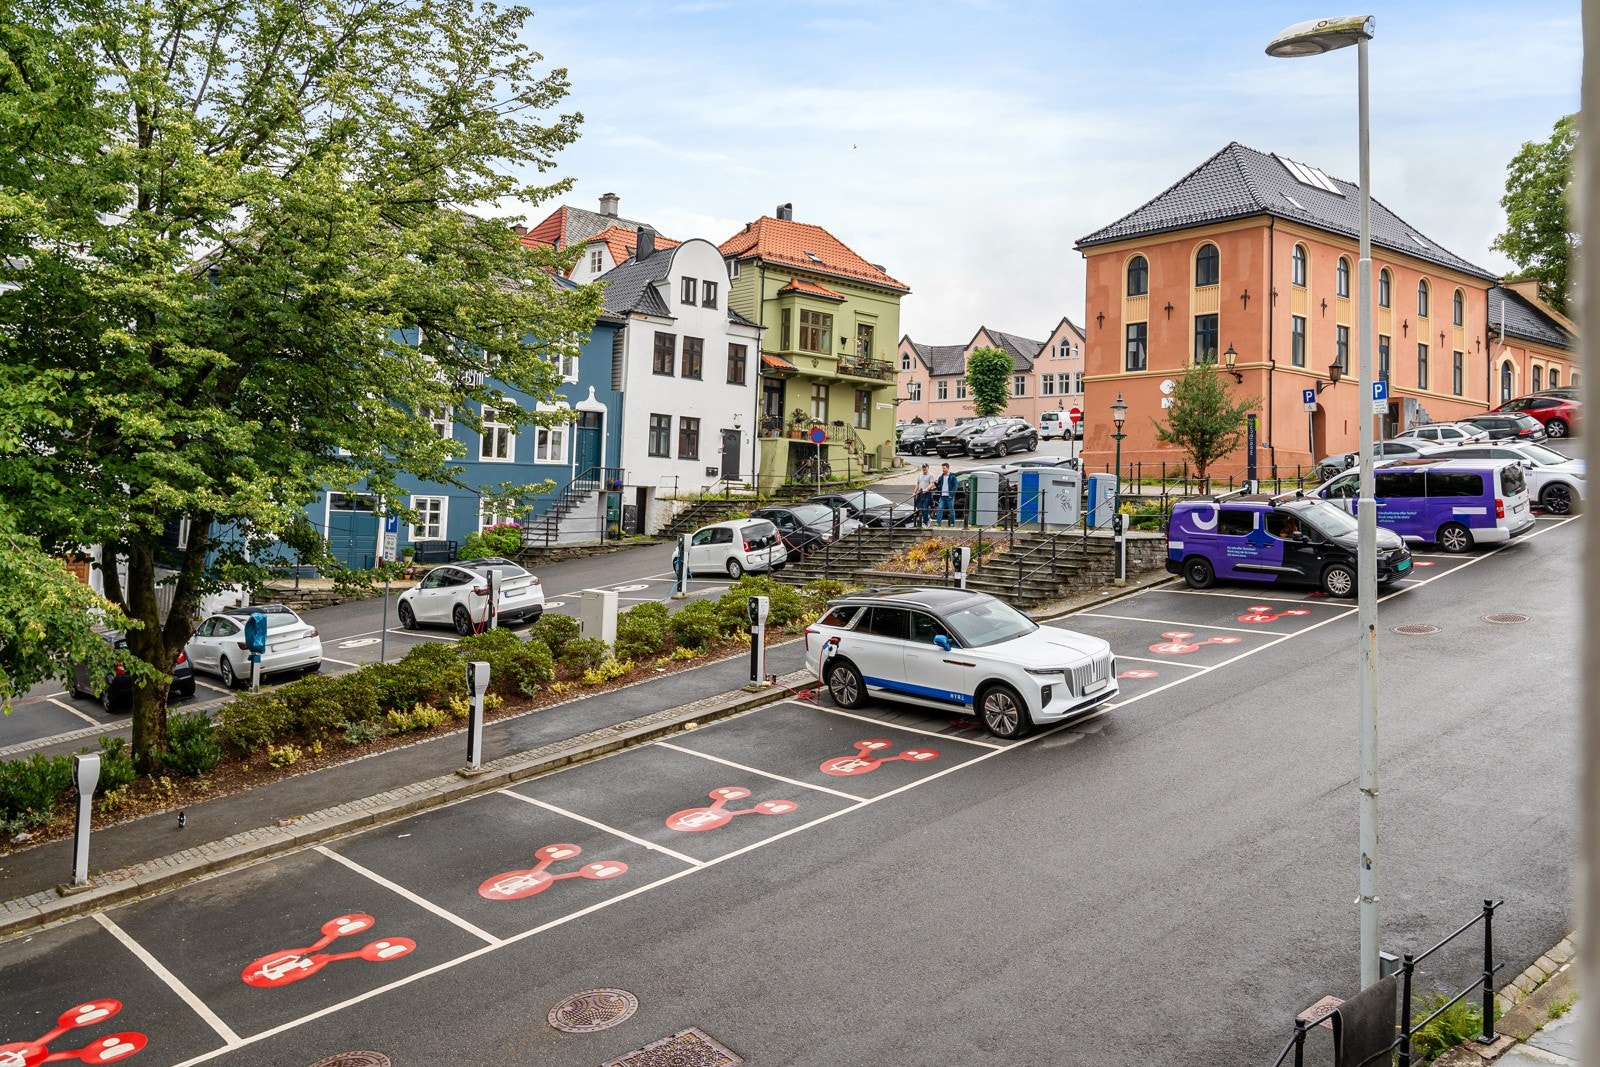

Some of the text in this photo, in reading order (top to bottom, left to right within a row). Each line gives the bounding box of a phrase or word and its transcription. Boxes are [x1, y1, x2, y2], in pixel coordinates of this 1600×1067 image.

[1306, 391, 1313, 402] P
[1374, 384, 1383, 398] P
[388, 515, 396, 530] P
